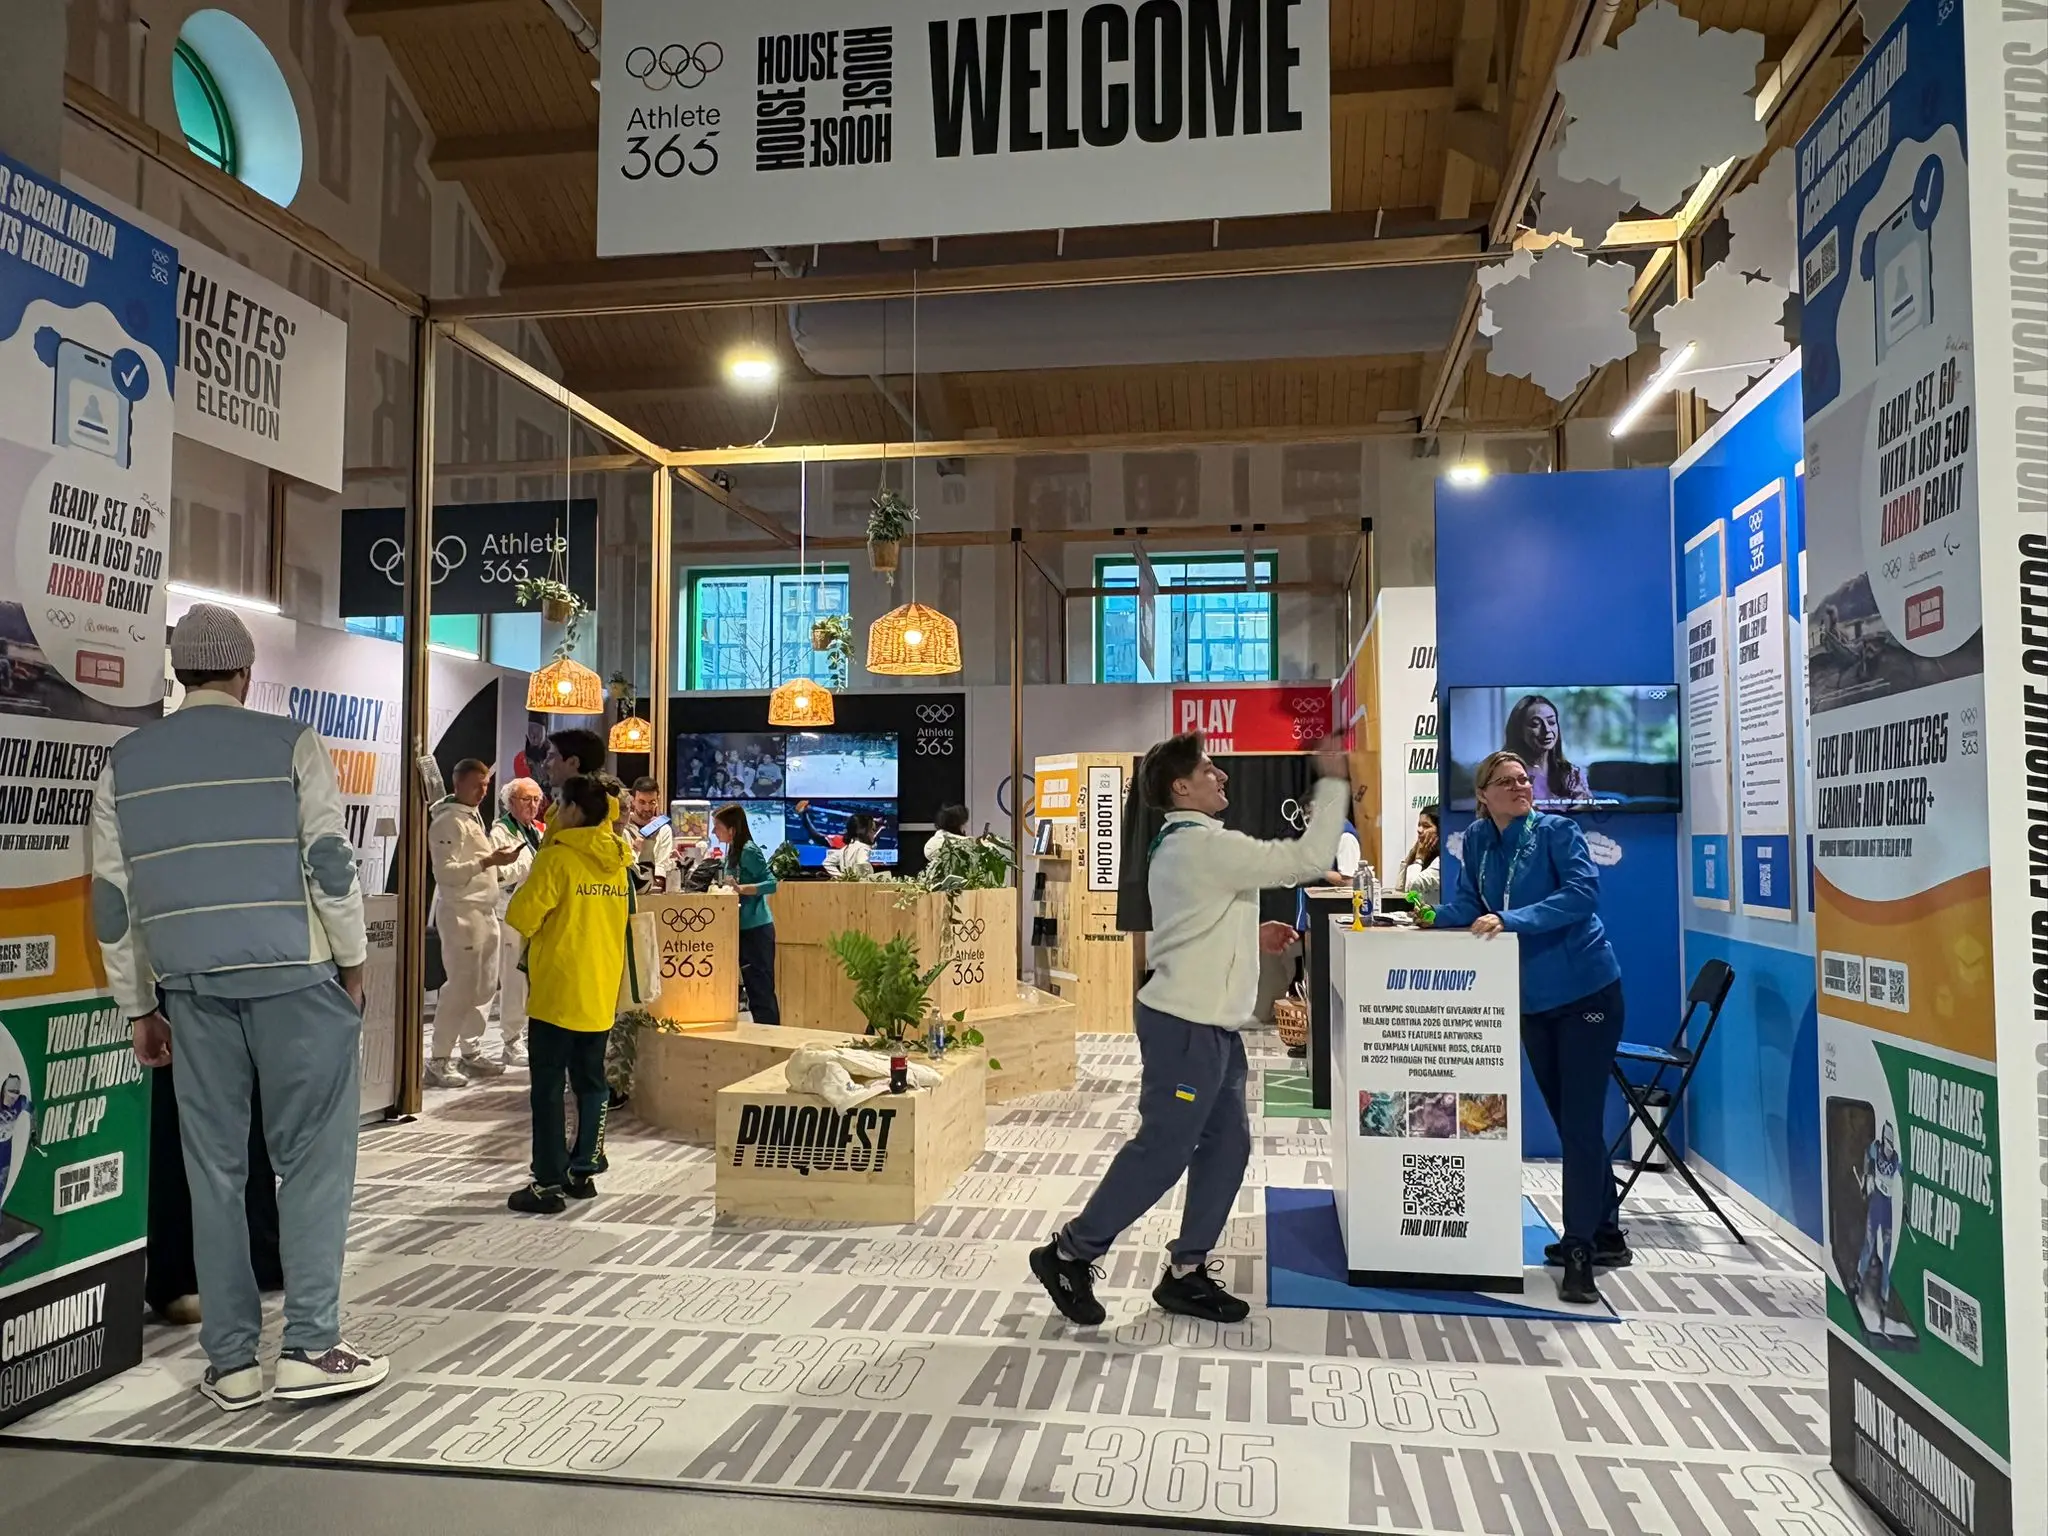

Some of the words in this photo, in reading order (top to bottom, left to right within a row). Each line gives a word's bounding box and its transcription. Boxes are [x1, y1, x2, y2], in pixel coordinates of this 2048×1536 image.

[757, 31, 839, 85] HOUSE
[843, 26, 892, 112] HOUSE
[928, 0, 1303, 158] WELCOME
[626, 103, 721, 132] Athlete
[756, 88, 805, 172] HOUSE
[810, 113, 892, 169] HOUSE
[620, 135, 720, 181] 365
[10, 173, 67, 234] SOCIAL
[67, 204, 116, 260] MEDIA
[22, 225, 89, 288] VERIFIED
[197, 381, 279, 441] ELECTION
[1878, 395, 1912, 449] READY,
[1915, 370, 1935, 425] SET,
[1939, 356, 1956, 407] GO
[1880, 442, 1906, 497] WITH
[1907, 440, 1916, 482] A
[1918, 421, 1942, 475] USD
[1945, 406, 1970, 462] 500
[49, 482, 99, 529] READY,
[102, 498, 128, 539] SET,
[131, 506, 151, 539] GO
[1881, 485, 1921, 547] AIRBNB
[1923, 463, 1964, 526] GRANT
[49, 522, 87, 561] WITH
[90, 534, 102, 565] A
[103, 537, 133, 572] USD
[134, 549, 162, 580] 500
[481, 532, 567, 556] Athlete
[47, 563, 104, 604] AIRBNB
[105, 576, 153, 614] GRANT
[480, 559, 530, 584] 365
[288, 687, 383, 741] SOLIDARITY
[917, 727, 954, 737] Athlete
[1181, 699, 1237, 734] PLAY
[1292, 725, 1325, 740] 365
[915, 738, 953, 756] 365
[1817, 731, 1839, 779] LEVEL
[1840, 730, 1853, 776] UP
[1854, 725, 1881, 774] WITH
[1881, 711, 1949, 772] ATHLETE365
[33, 786, 94, 826] CAREER
[1097, 794, 1113, 836] BOOTH
[1818, 784, 1861, 829] LEARNING
[1862, 782, 1884, 827] AND
[1885, 776, 1935, 826] CAREER+
[1097, 841, 1113, 885] PHOTO
[660, 955, 713, 979] 365
[663, 939, 714, 953] Athlete
[952, 962, 985, 986] 365
[1387, 969, 1409, 990] DID
[1410, 969, 1433, 990] YOU
[1433, 969, 1476, 991] KNOW?
[46, 1012, 86, 1055] YOUR
[1359, 1004, 1371, 1013] THE
[1373, 1005, 1403, 1014] OLYMPIC
[1405, 1005, 1444, 1014] SOLIDARITY
[1446, 1006, 1482, 1015] GIVEAWAY
[1483, 1006, 1491, 1015] AT
[1493, 1006, 1505, 1015] THE
[1362, 1017, 1390, 1026] MILANO
[1391, 1018, 1421, 1026] CORTINA
[1423, 1018, 1441, 1027] 2026
[1443, 1019, 1473, 1028] OLYMPIC
[1474, 1019, 1502, 1028] WINTER
[1382, 1030, 1406, 1039] GAMES
[1408, 1030, 1442, 1039] FEATURES
[1443, 1031, 1483, 1040] ARTWORKS
[1361, 1055, 1369, 1063] IN
[1370, 1055, 1388, 1064] 2022
[1390, 1055, 1423, 1064] THROUGH
[1424, 1056, 1436, 1064] THE
[1438, 1056, 1474, 1065] OLYMPIAN
[1475, 1057, 1504, 1066] ARTISTS
[1363, 1042, 1372, 1051] BY
[1374, 1043, 1409, 1051] OLYMPIAN
[1410, 1043, 1447, 1052] LAURENNE
[1448, 1044, 1469, 1053] ROSS,
[1471, 1044, 1502, 1053] CREATED
[1408, 1068, 1456, 1078] PROGRAMME.
[44, 1060, 86, 1100] YOUR
[86, 1050, 144, 1090] PHOTOS,
[41, 1103, 75, 1145] ONE
[76, 1095, 106, 1137] APP
[1907, 1067, 1939, 1123] YOUR
[1939, 1078, 1987, 1149] GAMES,
[1909, 1125, 1941, 1181] YOUR
[1941, 1137, 1994, 1216] PHOTOS,
[1400, 1219, 1421, 1236] FIND
[1421, 1220, 1441, 1236] OUT
[1441, 1220, 1469, 1238] MORE
[1910, 1182, 1934, 1240] ONE
[1934, 1197, 1961, 1251] APP
[2, 1283, 106, 1363] COMMUNITY
[0, 1327, 105, 1412] COMMUNITY
[417, 1318, 933, 1401] ATHLETE365
[958, 1345, 1500, 1437] ATHLETE365
[1545, 1374, 1831, 1455] ATHLET
[678, 1403, 1278, 1518] ATHLETE365
[1854, 1378, 1877, 1442] JOIN
[1876, 1397, 1897, 1460] THE
[1897, 1416, 1975, 1534] COMMUNITY
